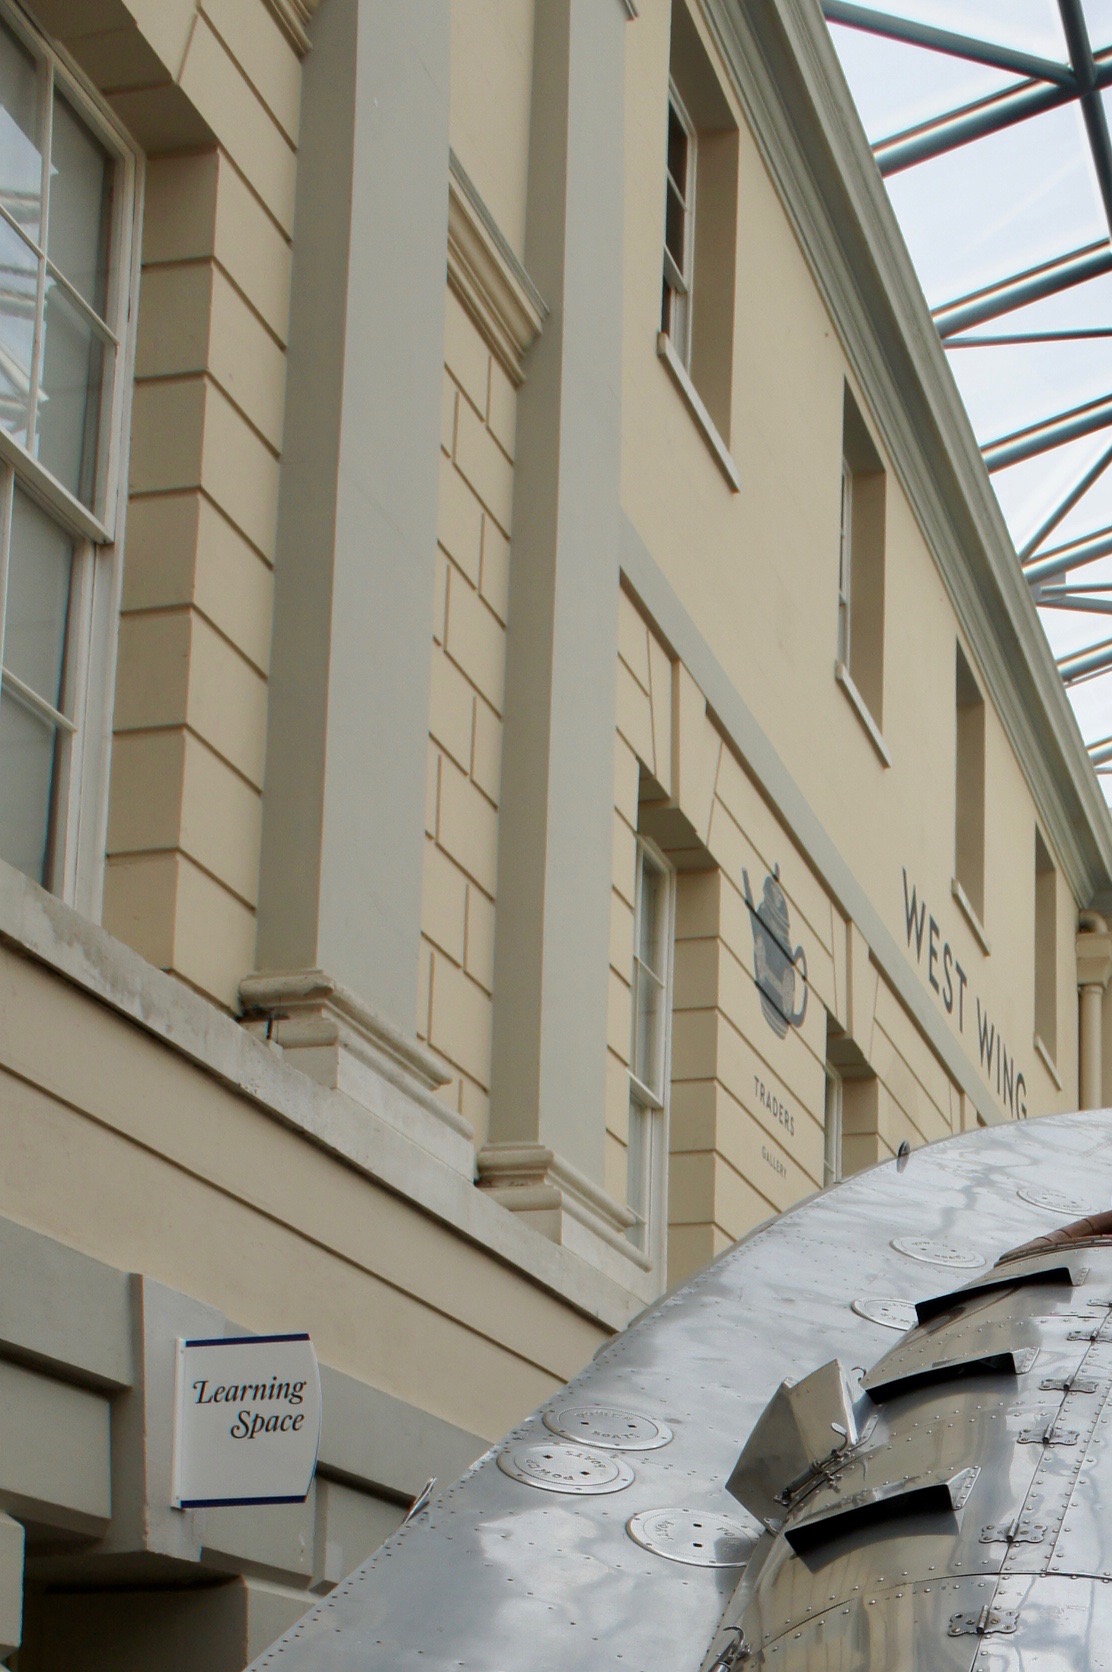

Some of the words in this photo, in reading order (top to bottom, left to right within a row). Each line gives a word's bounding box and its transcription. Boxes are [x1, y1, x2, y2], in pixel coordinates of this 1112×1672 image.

[901, 866, 968, 1033] WEST
[975, 997, 1028, 1120] WING
[753, 1075, 796, 1137] TRADERS
[761, 1145, 788, 1179] GALLERY
[192, 1375, 308, 1405] Learning
[230, 1410, 305, 1440] Space
